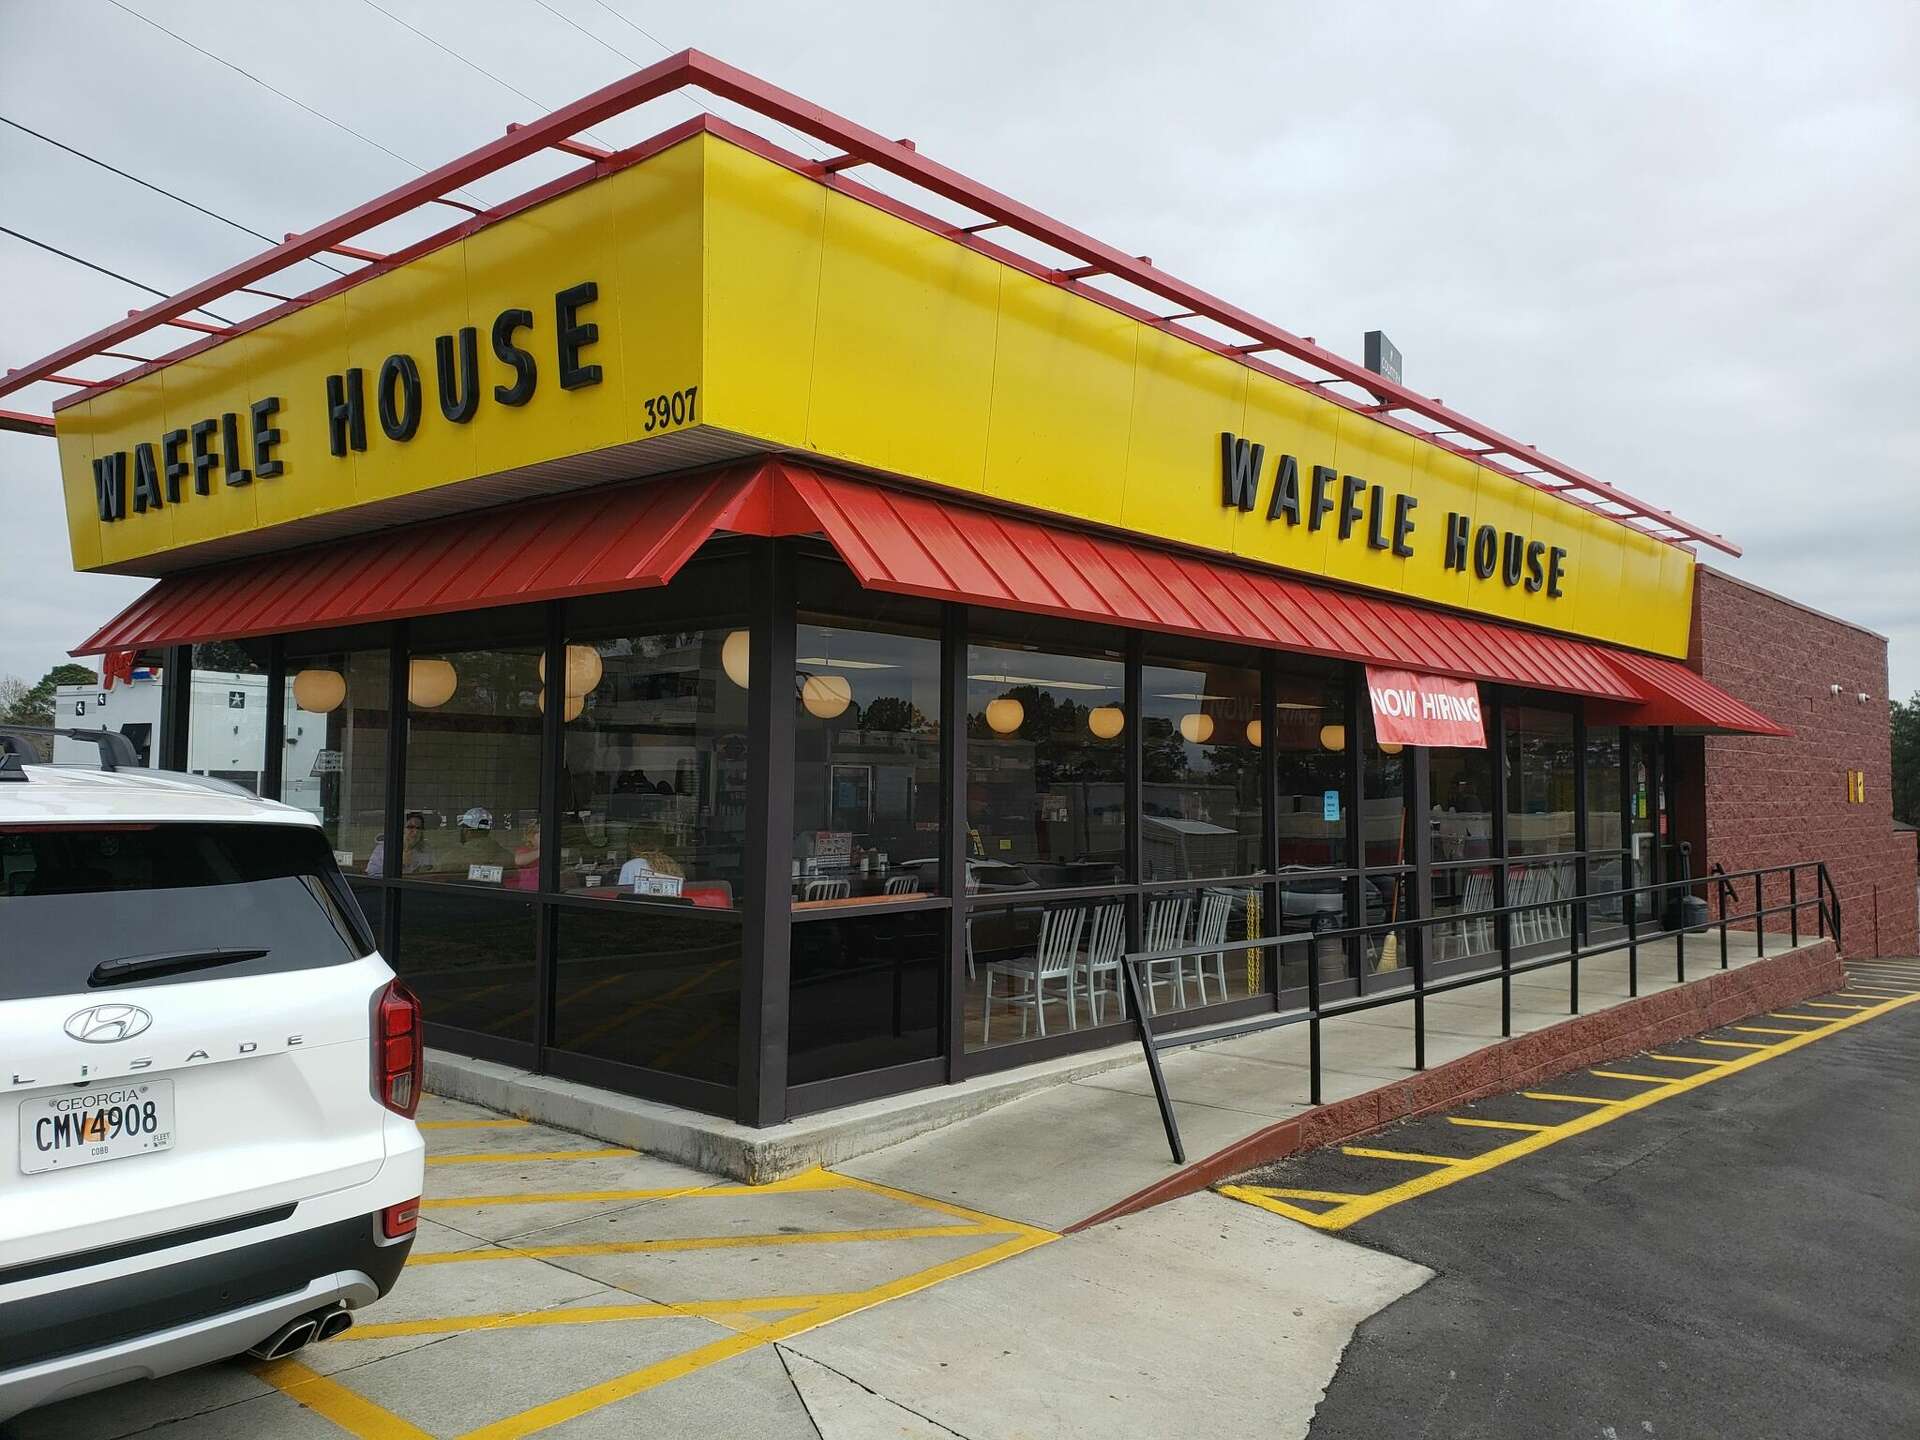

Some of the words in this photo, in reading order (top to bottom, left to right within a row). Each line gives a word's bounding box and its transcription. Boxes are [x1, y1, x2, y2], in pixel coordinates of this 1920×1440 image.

[92, 397, 284, 522] WAFFLE
[326, 281, 603, 457] HOUSE
[644, 386, 698, 432] 3907
[1221, 432, 1418, 557] WAFFLE
[1445, 511, 1567, 598] HOUSE
[1370, 686, 1416, 718] NOW
[1421, 692, 1480, 722] HIRING
[57, 1089, 139, 1112] GEORGIA
[36, 1101, 157, 1151] CMV4908
[92, 1146, 109, 1156] COBB
